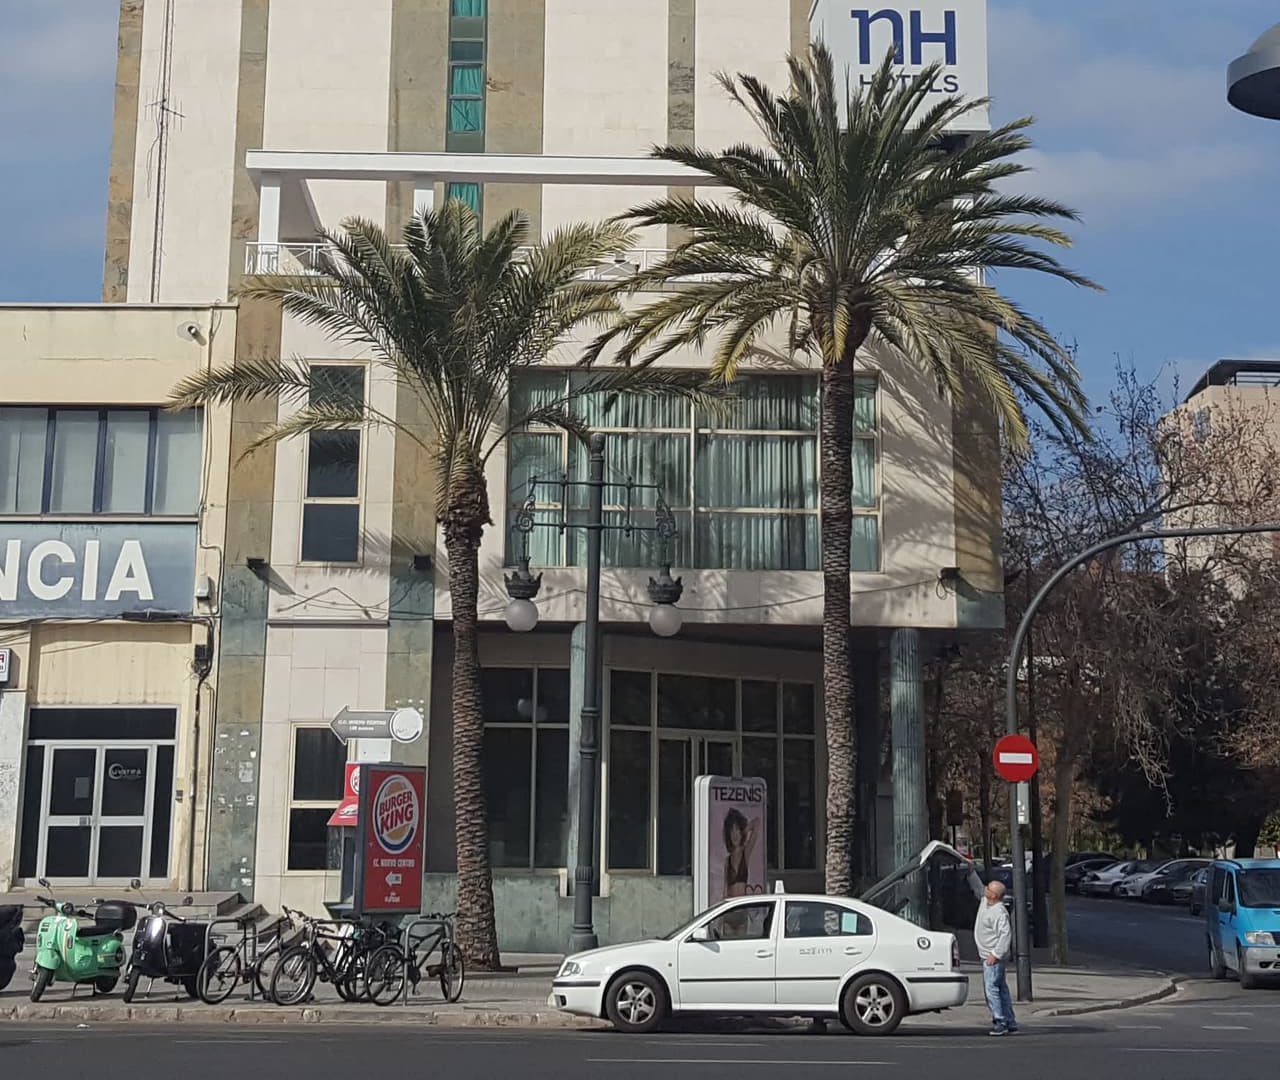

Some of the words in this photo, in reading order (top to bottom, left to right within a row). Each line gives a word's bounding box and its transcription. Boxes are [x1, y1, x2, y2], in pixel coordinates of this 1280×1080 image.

[379, 790, 413, 817] BURGER
[712, 786, 763, 802] TEZENIS
[379, 803, 414, 835] KING
